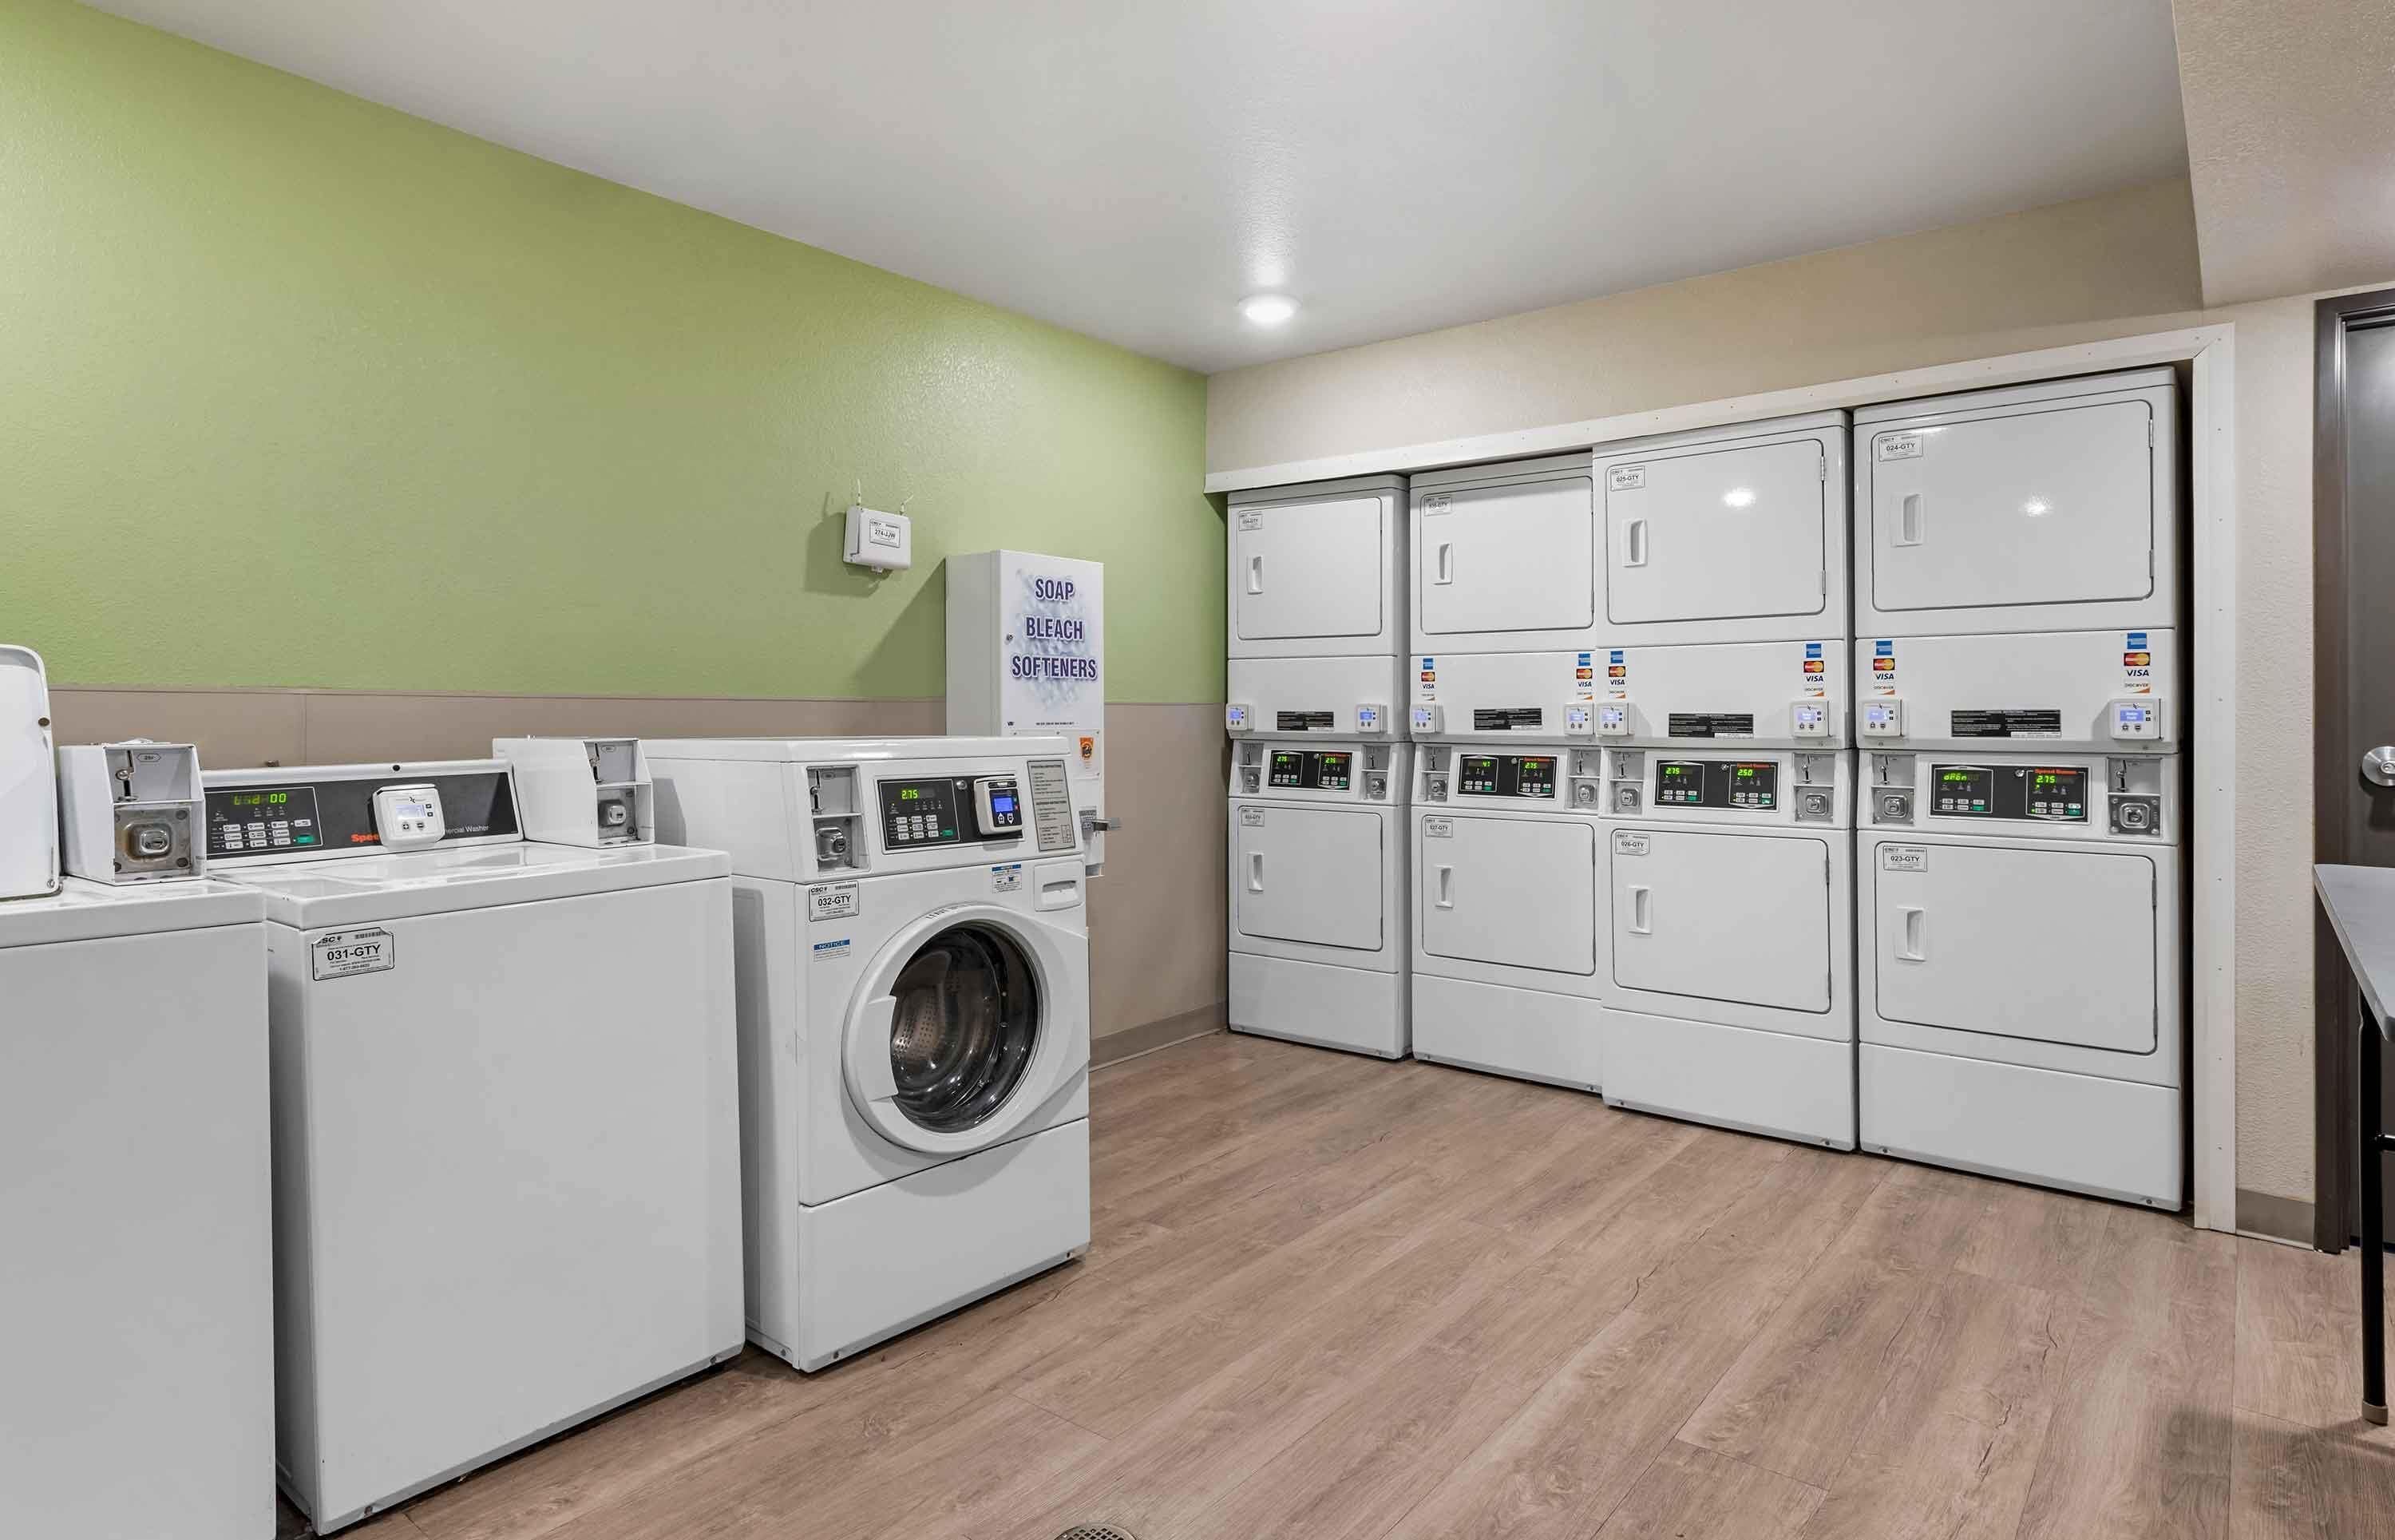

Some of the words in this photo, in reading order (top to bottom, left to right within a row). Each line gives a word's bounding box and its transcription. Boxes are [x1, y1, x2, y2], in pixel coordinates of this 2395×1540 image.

[1886, 442, 1915, 451] 024-GTY
[1035, 578, 1074, 600] SOAP
[1026, 616, 1083, 639] BLEACH
[1012, 655, 1097, 679] SOFTENERS
[901, 789, 918, 799] 2.75
[350, 833, 379, 844] Spee
[817, 894, 852, 907] 032-GTY
[327, 944, 382, 961] 031-GTY
